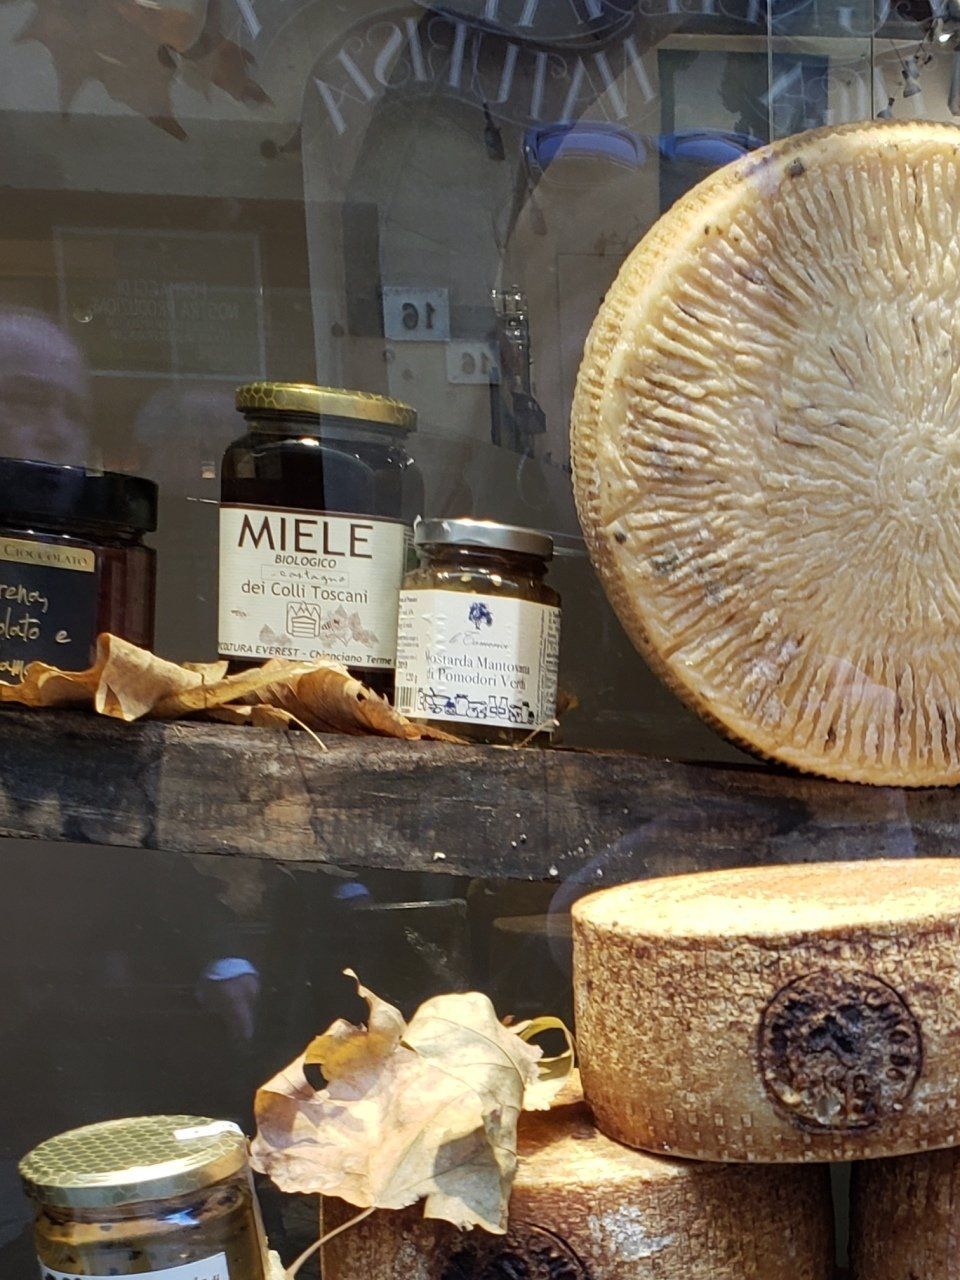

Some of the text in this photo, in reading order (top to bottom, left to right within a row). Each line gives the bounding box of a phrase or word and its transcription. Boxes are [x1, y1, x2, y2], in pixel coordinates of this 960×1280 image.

[238, 514, 374, 559] MIELE
[275, 554, 337, 569] BIOLOGICO
[241, 579, 368, 604] dei Colli Toscani
[255, 645, 300, 656] EVEREST
[366, 654, 393, 666] Terme
[438, 668, 497, 687] Pomodori
[501, 675, 527, 691] Verdi
